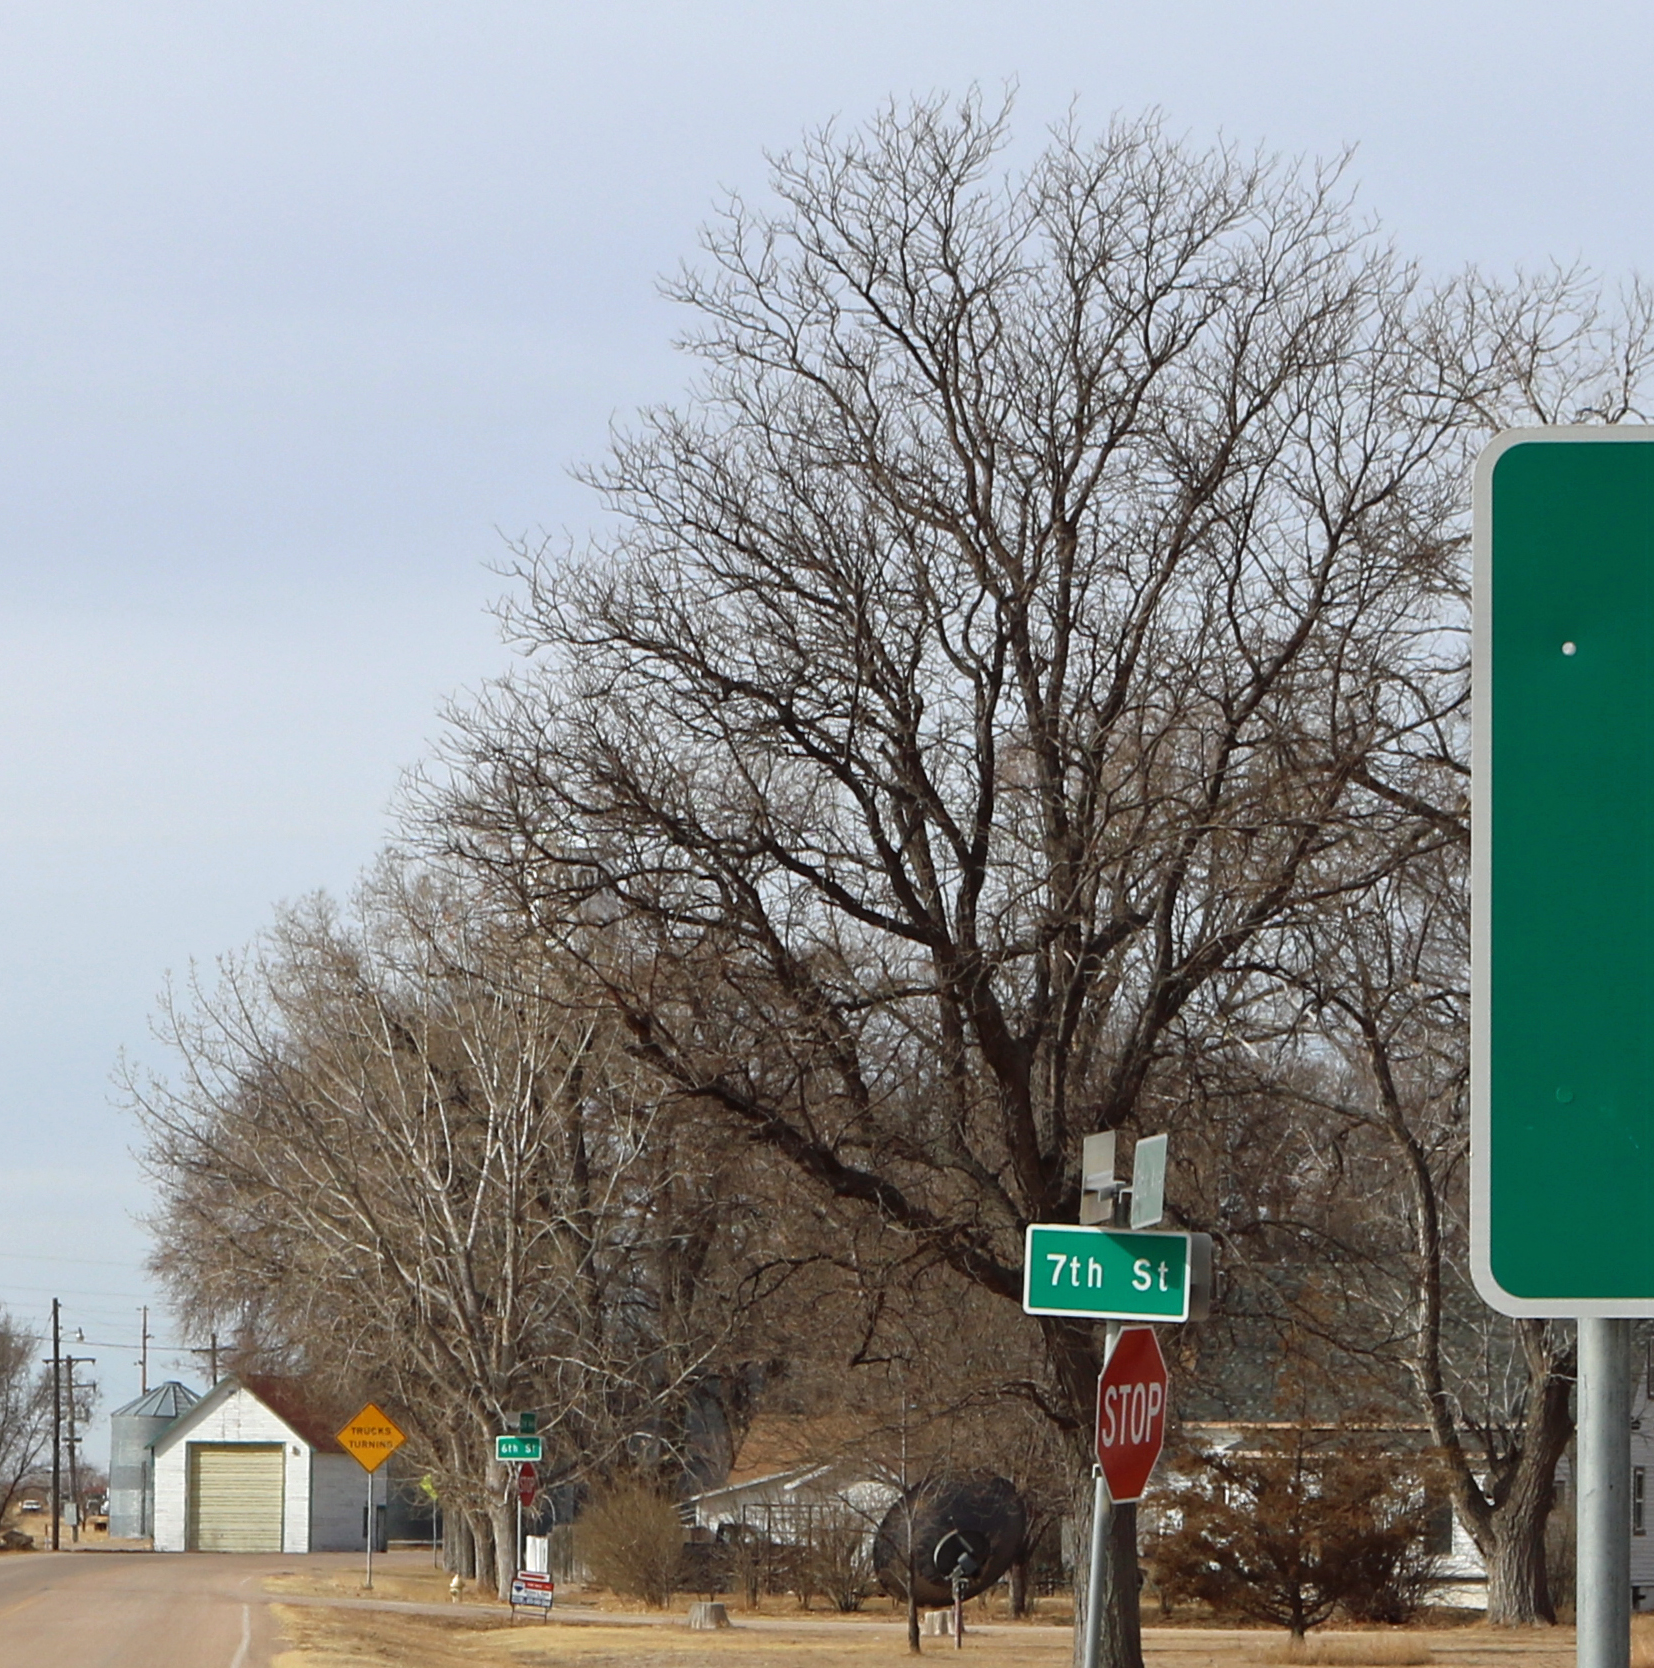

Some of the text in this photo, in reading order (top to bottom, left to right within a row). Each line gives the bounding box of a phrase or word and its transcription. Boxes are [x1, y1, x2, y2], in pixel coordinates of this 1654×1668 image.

[1046, 1253, 1169, 1292] 7th St
[1101, 1382, 1163, 1448] STOP
[351, 1426, 392, 1436] TRUCKS
[348, 1440, 394, 1449] TURNING
[501, 1443, 536, 1454] 6th St
